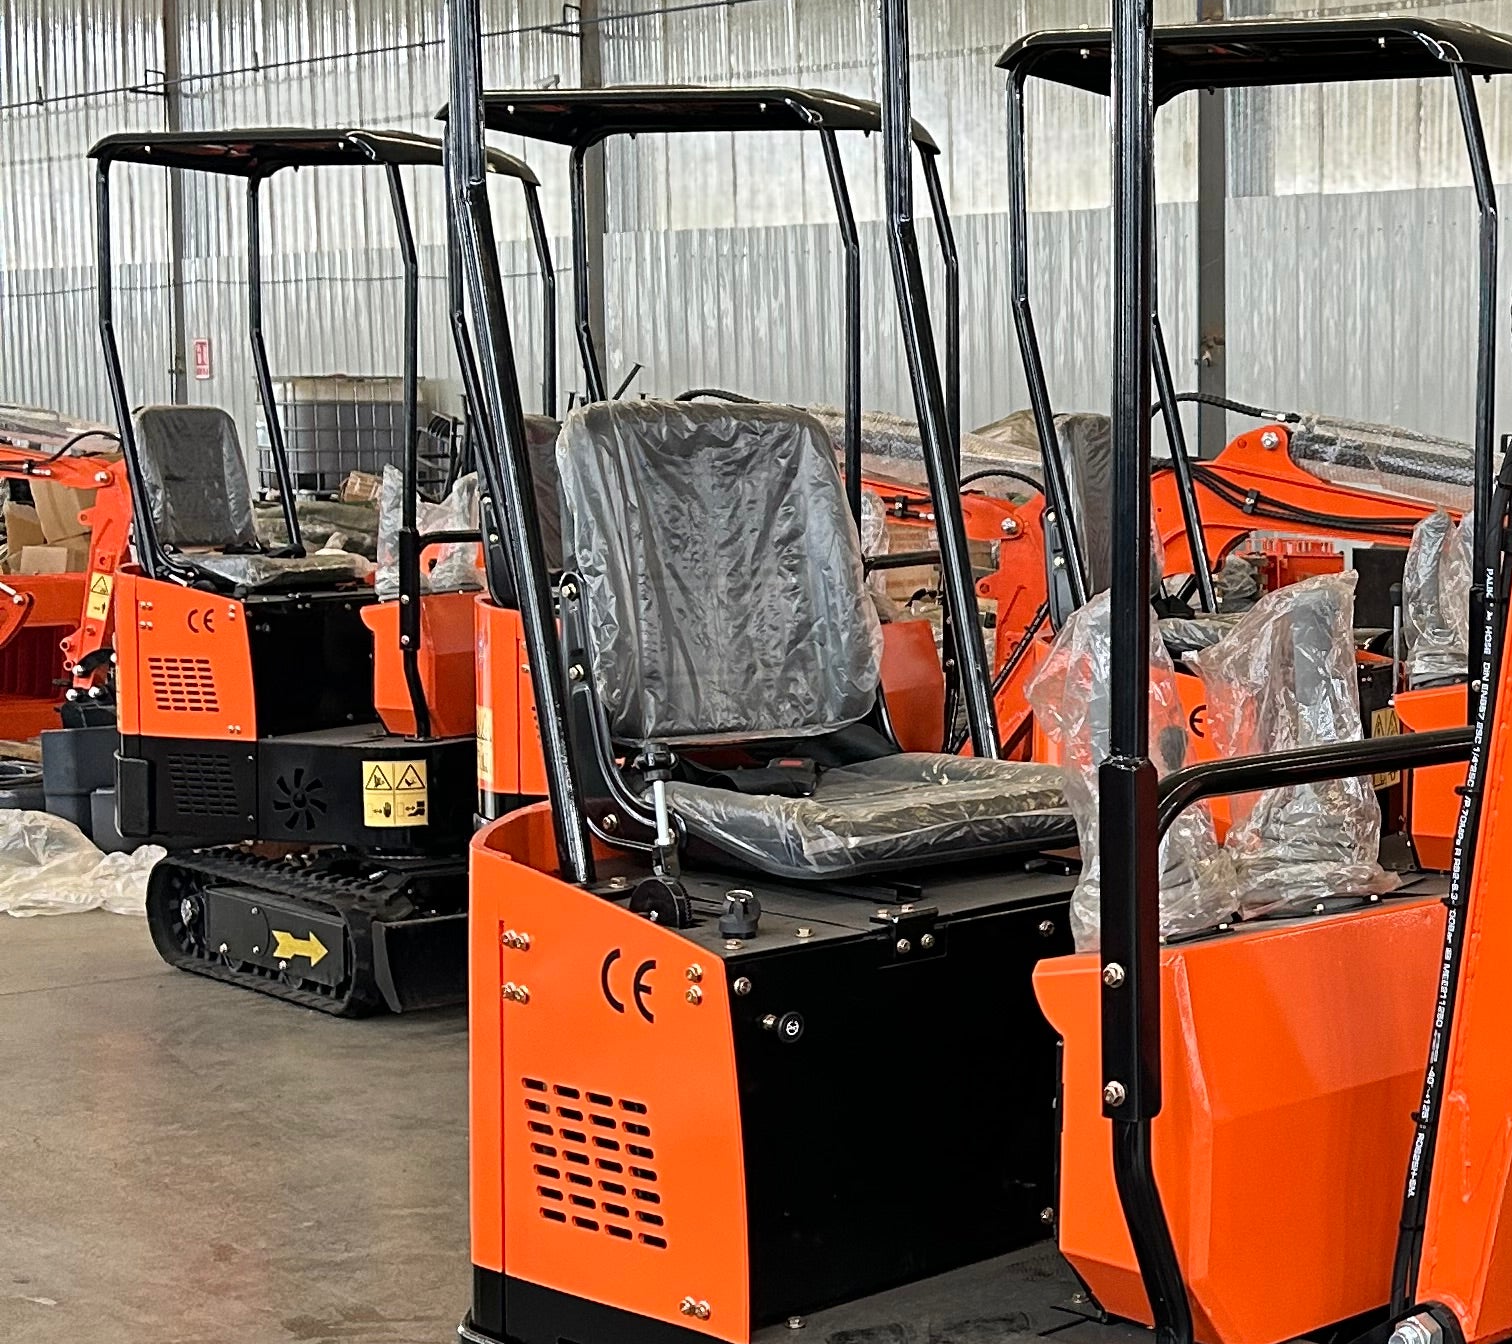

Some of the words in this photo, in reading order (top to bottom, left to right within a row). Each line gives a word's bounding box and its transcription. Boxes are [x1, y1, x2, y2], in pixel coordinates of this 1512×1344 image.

[187, 608, 216, 634] CE
[1484, 626, 1494, 655] HOSE
[1482, 662, 1491, 681] DIN
[601, 948, 657, 1025] CE
